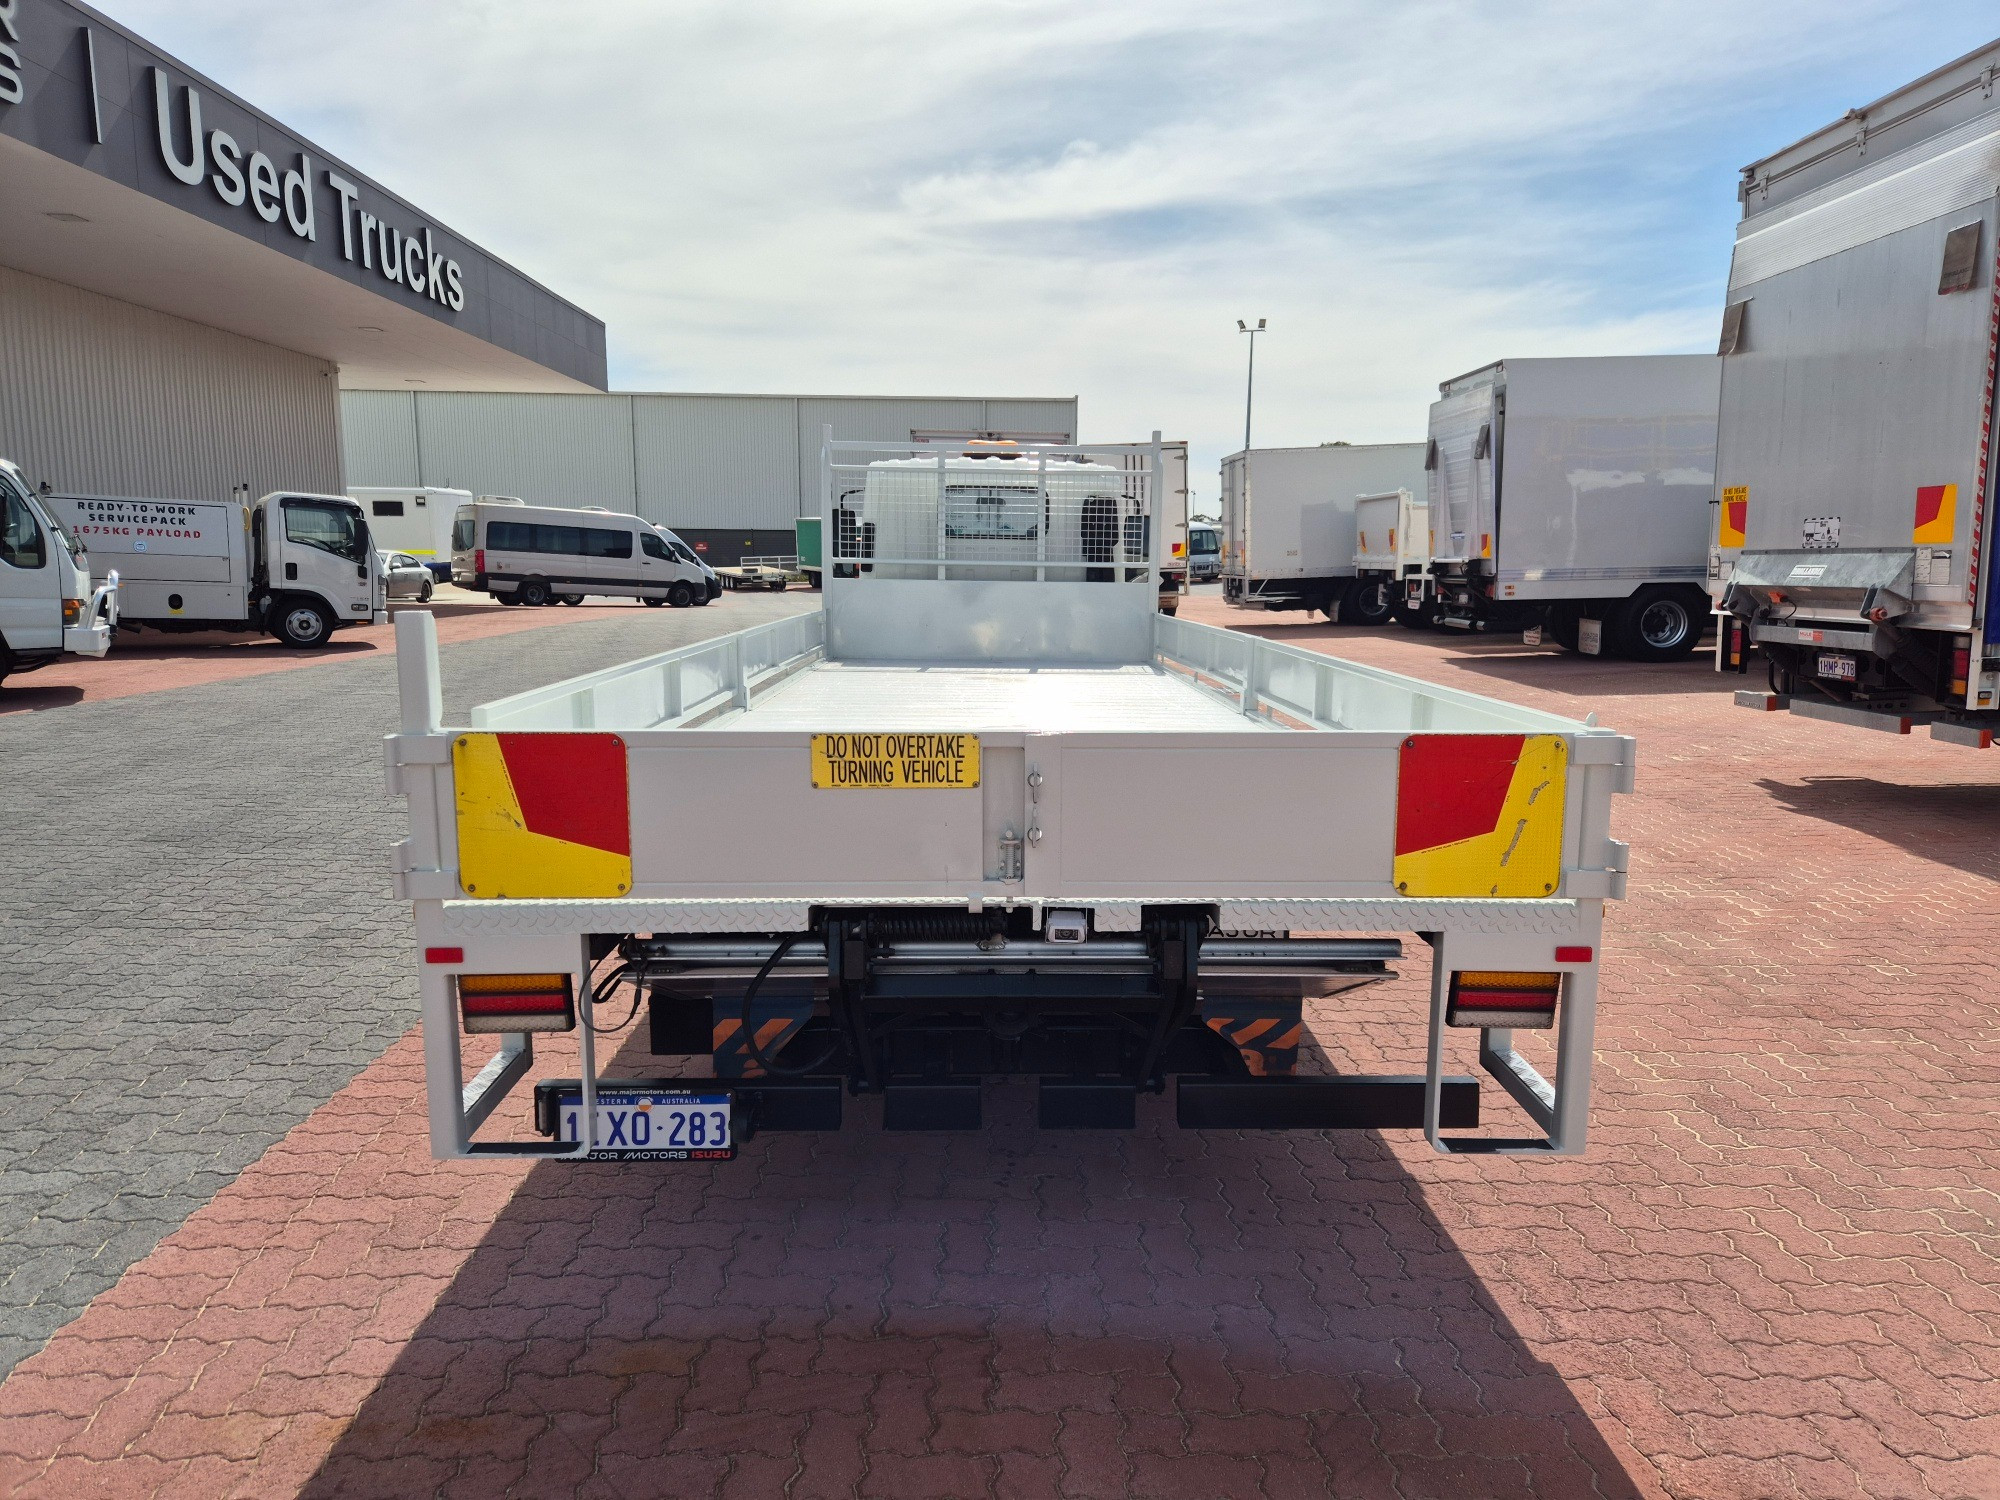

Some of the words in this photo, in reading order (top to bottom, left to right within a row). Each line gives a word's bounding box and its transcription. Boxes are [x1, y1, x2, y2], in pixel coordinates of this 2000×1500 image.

[150, 66, 316, 242] Used
[325, 171, 464, 312] Trucks
[77, 501, 196, 515] READY-TO-WORK
[88, 513, 187, 525] SERVICEPACK
[72, 525, 130, 536] 1675KG
[136, 527, 201, 539] PAYLOAD
[826, 735, 848, 759] DO
[852, 735, 882, 759] NOT
[886, 735, 965, 759] OVERTAKE
[828, 760, 894, 783] TURNING
[901, 760, 964, 783] VEHICLE
[1207, 925, 1276, 938] AJOR
[599, 1088, 691, 1096] www.majormotors.com.au
[623, 1151, 688, 1160] MOTORS
[691, 1150, 731, 1159] ISUZU
